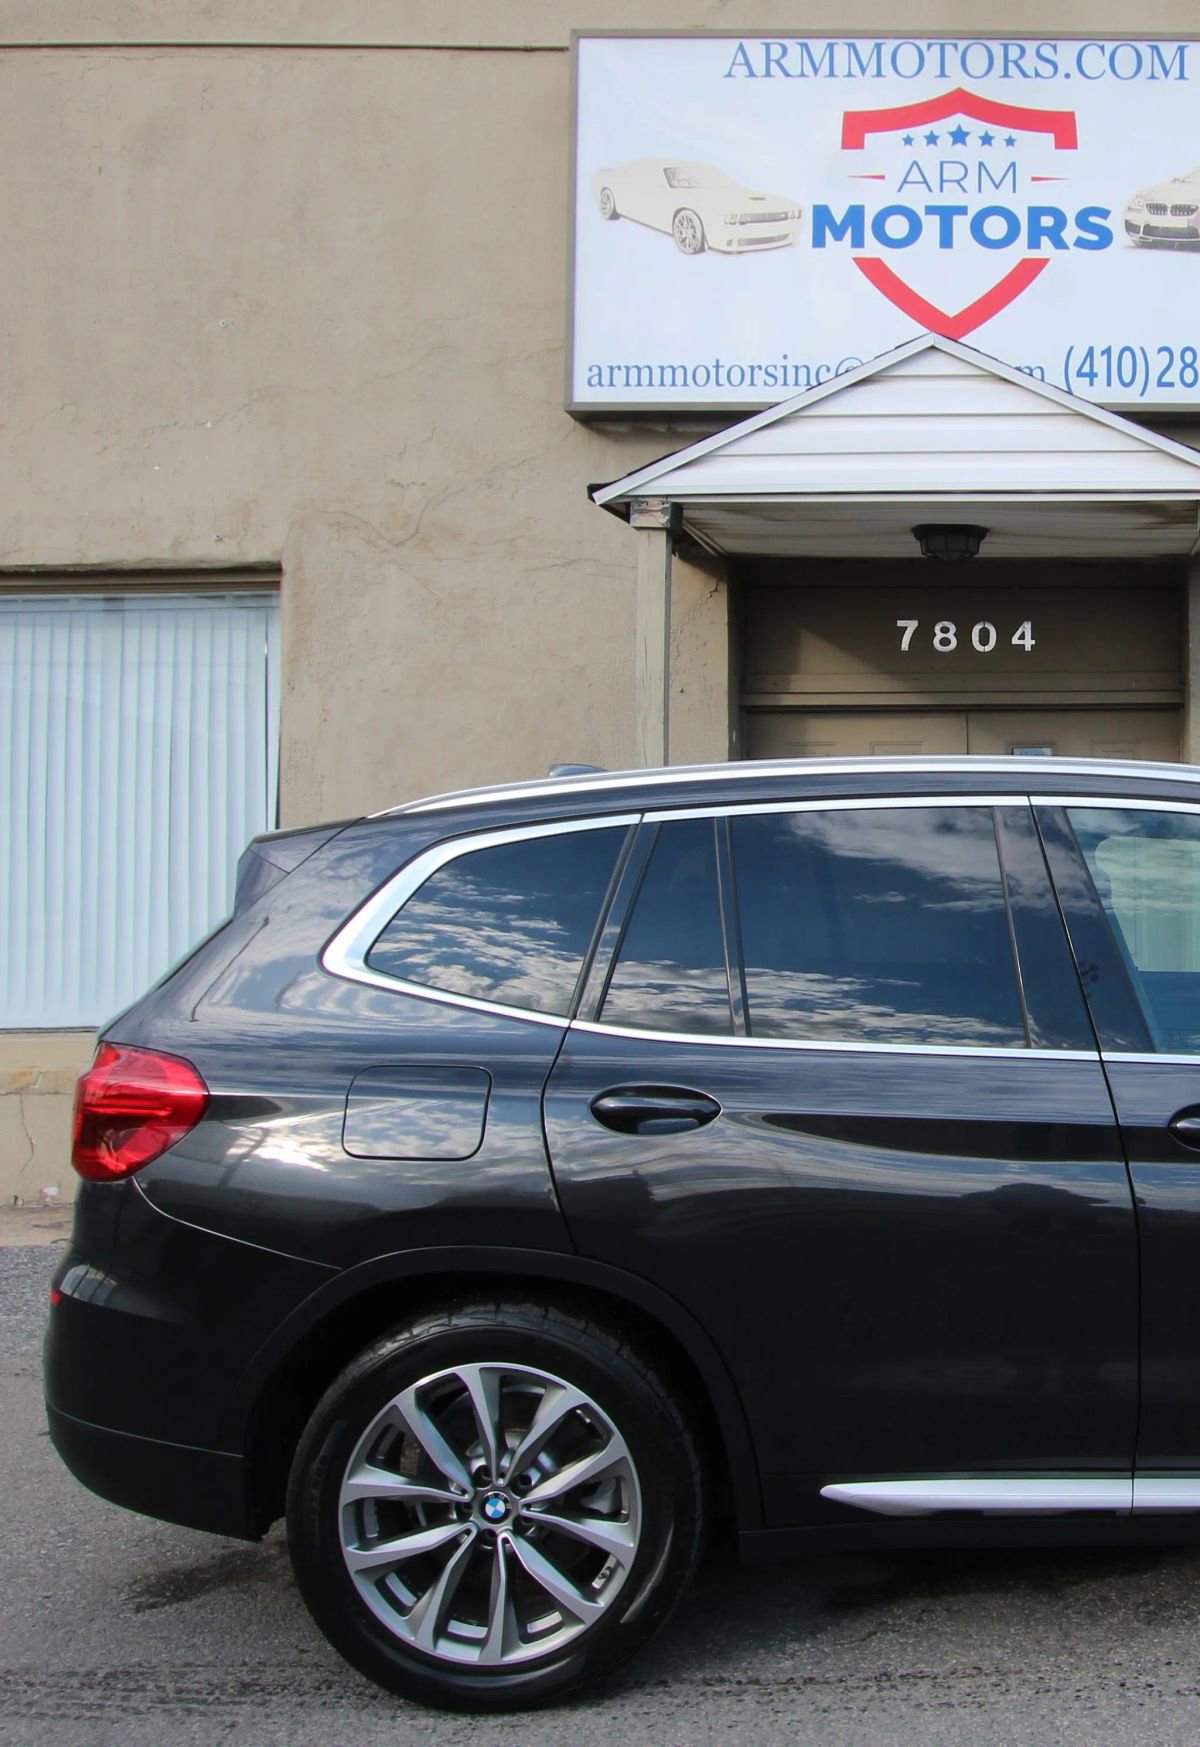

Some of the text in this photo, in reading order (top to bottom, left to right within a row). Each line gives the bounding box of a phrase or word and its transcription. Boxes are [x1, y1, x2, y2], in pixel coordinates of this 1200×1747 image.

[723, 41, 1190, 81] ARMMOTORS.COM
[896, 160, 1017, 194] ARM
[811, 204, 1114, 252] MOTORS
[896, 619, 1036, 653] 7804
